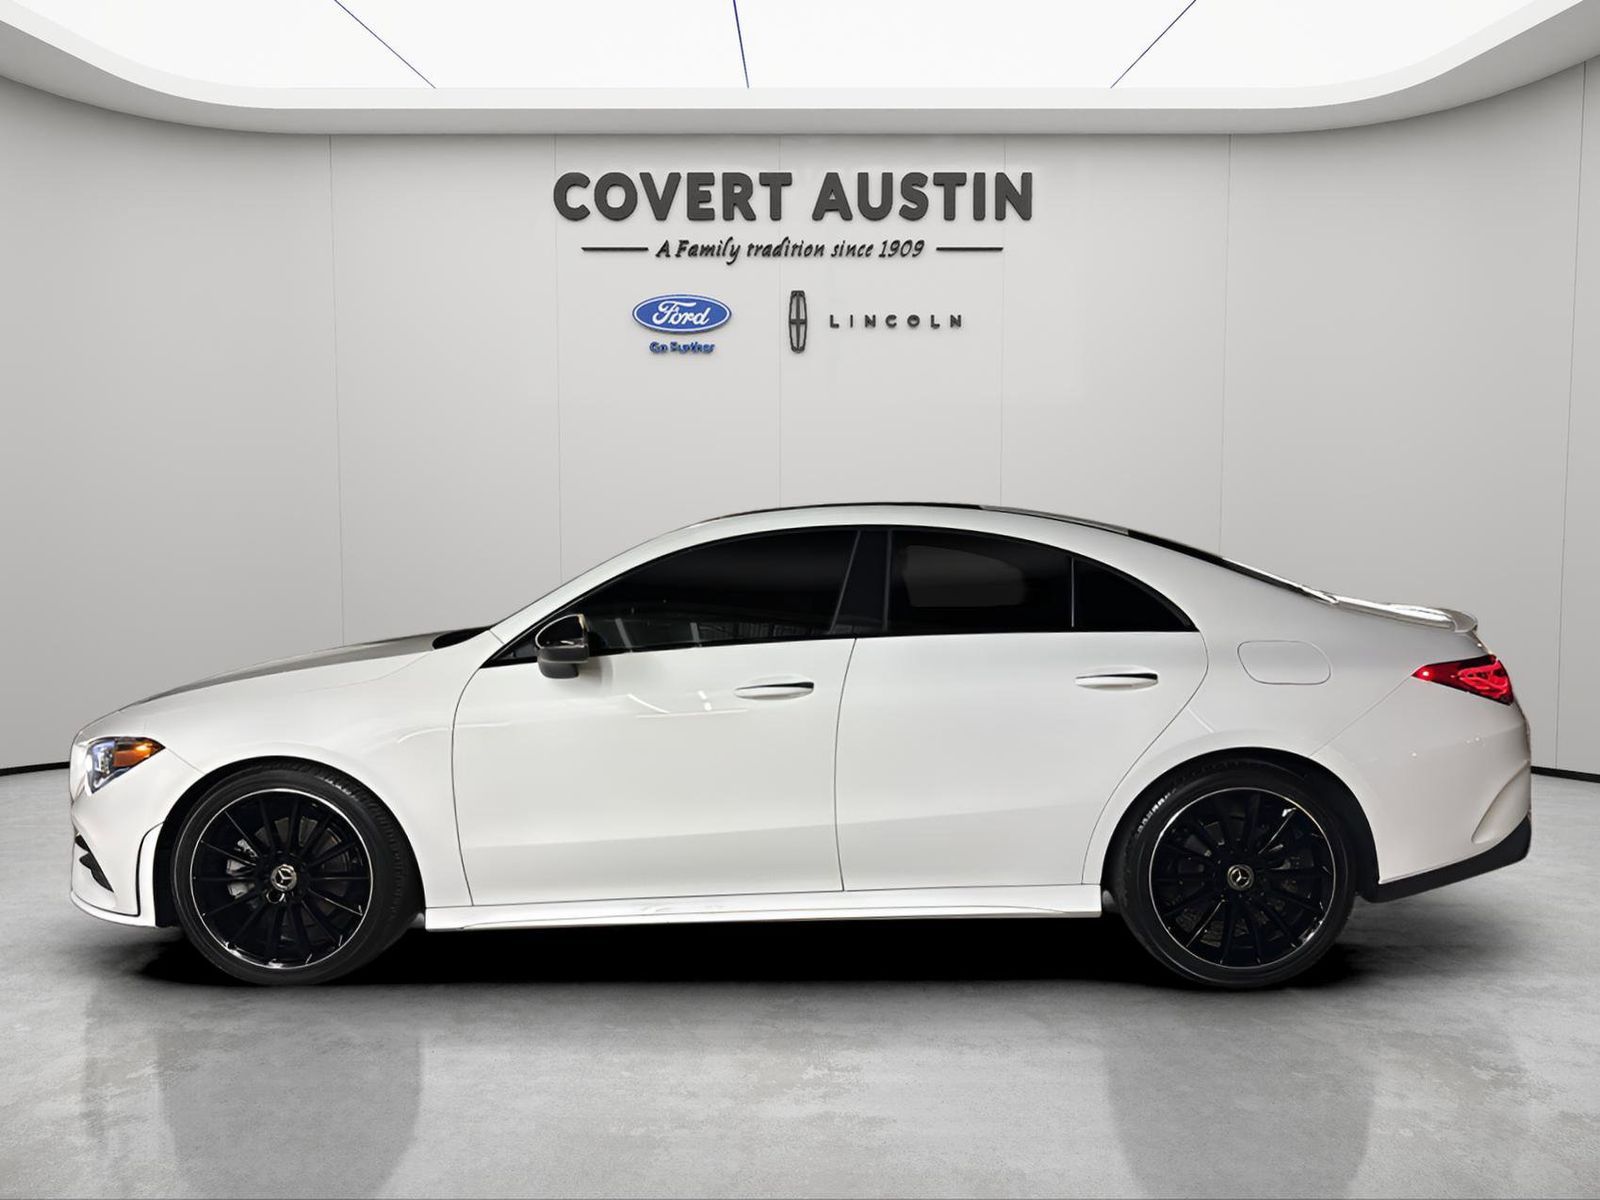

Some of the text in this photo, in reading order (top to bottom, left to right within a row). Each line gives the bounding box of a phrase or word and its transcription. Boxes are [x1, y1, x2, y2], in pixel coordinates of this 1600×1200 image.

[553, 172, 1033, 222] COVERT AUSTIN
[655, 237, 925, 266] A Family tradition since 1909
[652, 300, 711, 325] Ford
[829, 314, 962, 329] LINCOLN
